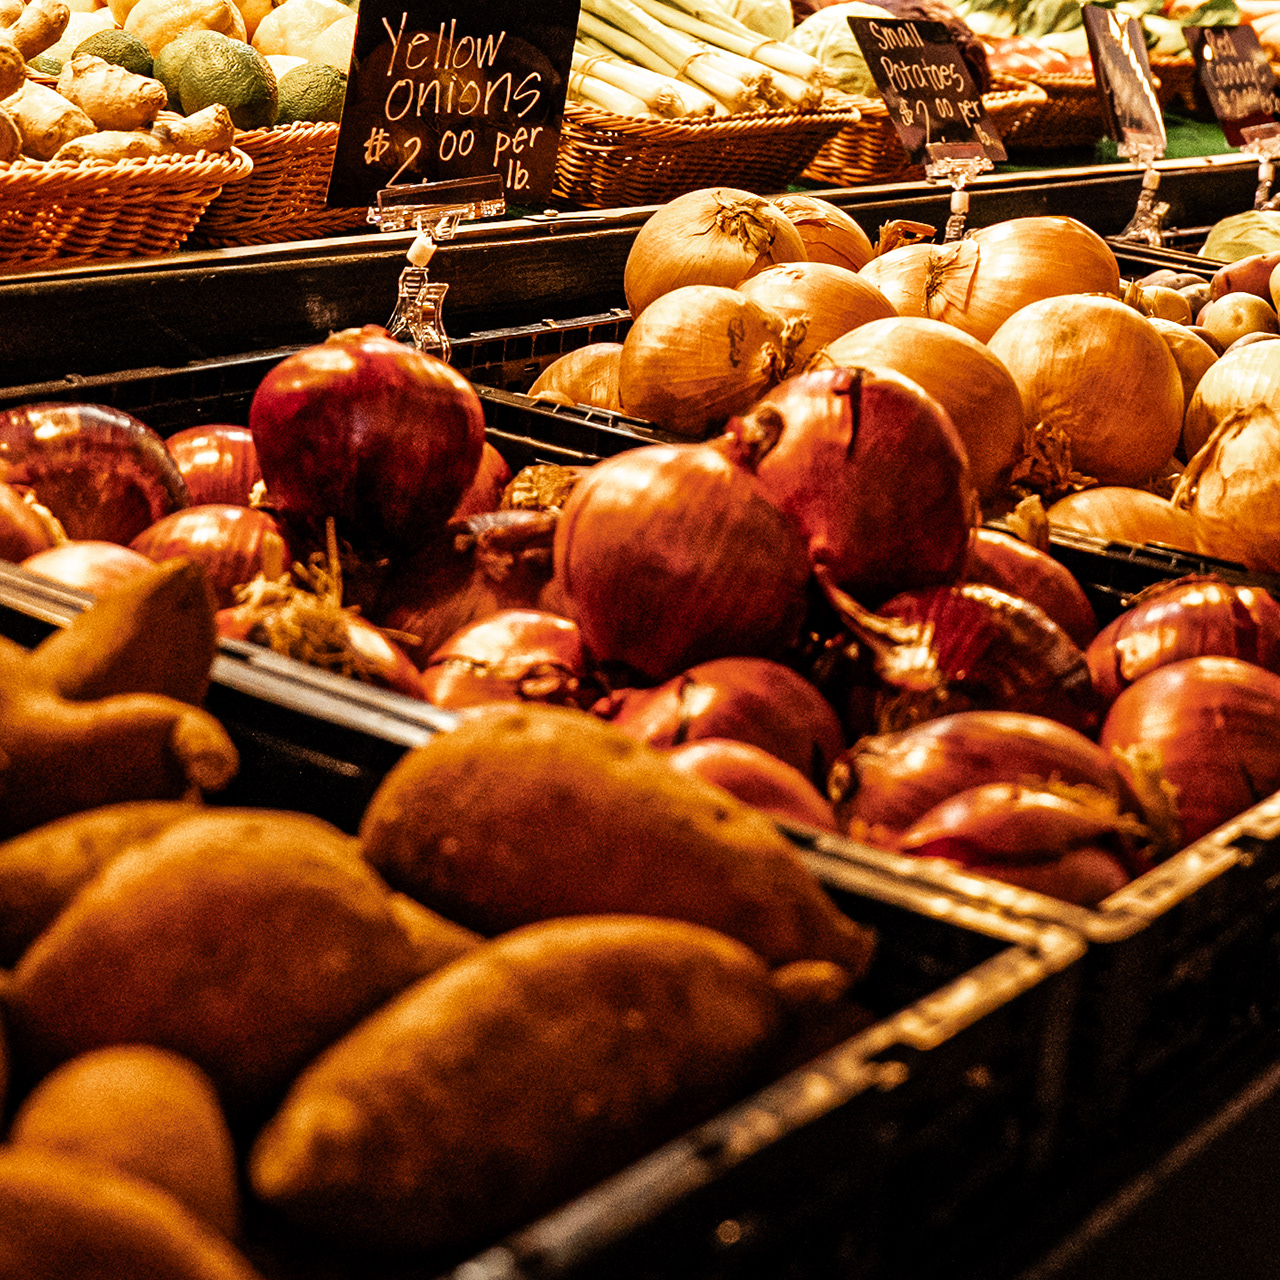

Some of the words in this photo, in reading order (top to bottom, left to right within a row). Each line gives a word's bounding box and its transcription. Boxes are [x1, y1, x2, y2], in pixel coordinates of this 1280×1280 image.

[382, 12, 506, 77] Yellow
[869, 21, 924, 50] Small
[880, 56, 964, 93] Potatoes
[958, 99, 982, 128] per
[493, 126, 544, 168] per
